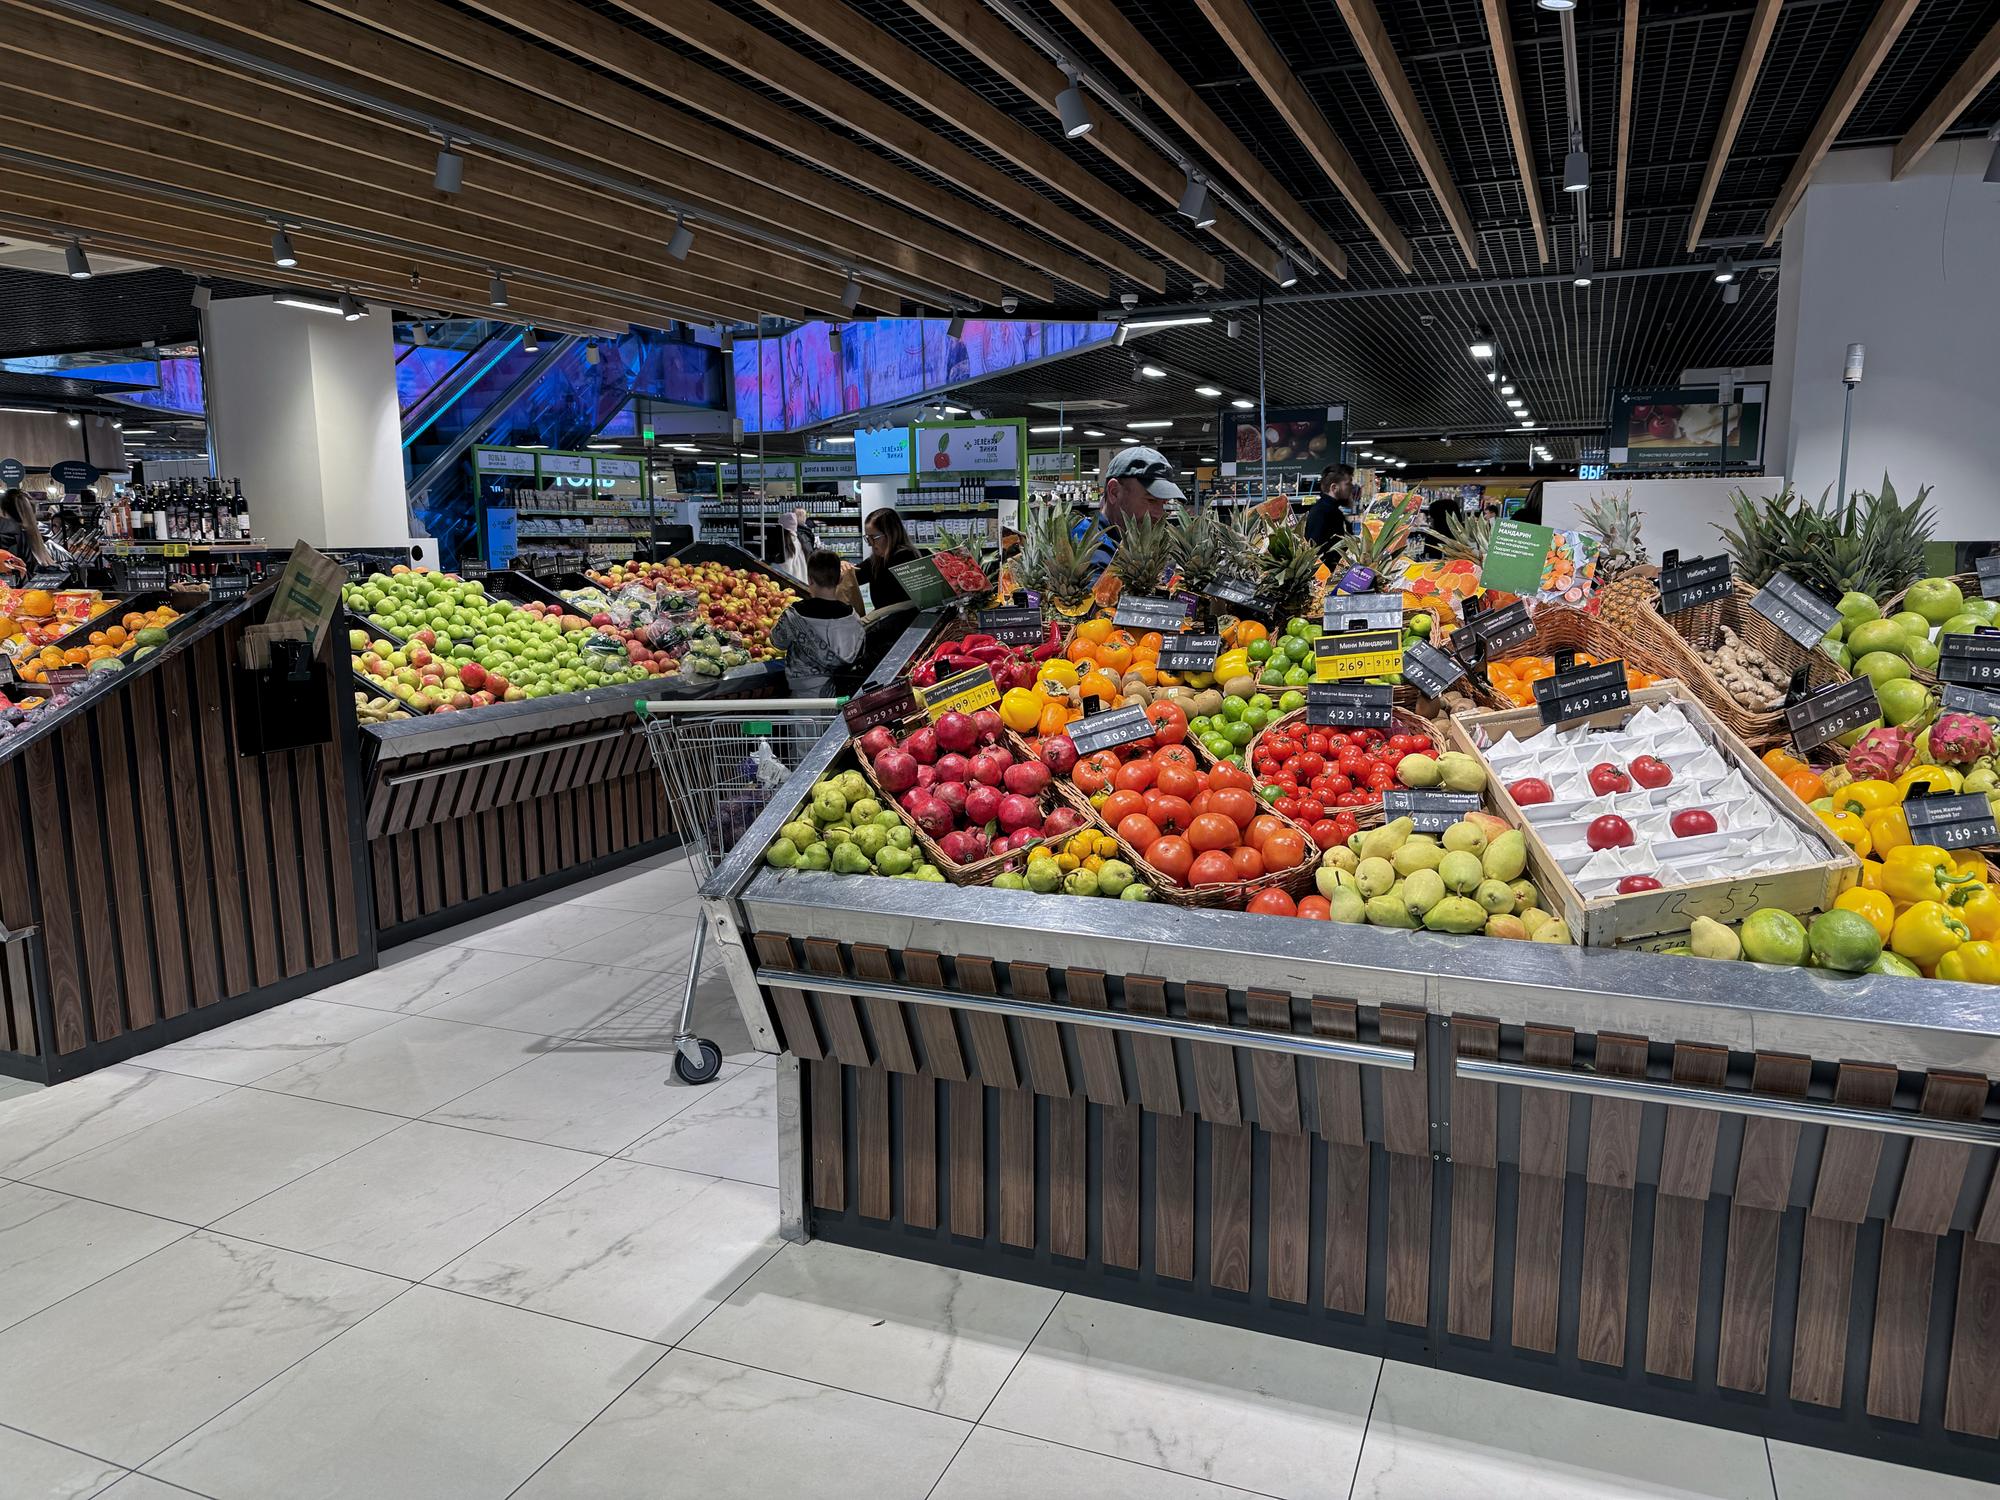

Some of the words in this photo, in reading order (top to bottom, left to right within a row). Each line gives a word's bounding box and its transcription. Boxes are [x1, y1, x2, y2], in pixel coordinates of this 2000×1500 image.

[1500, 521, 1518, 529] МИНИ
[1498, 528, 1532, 539] МАНДАРИН
[1358, 640, 1393, 648] Мандарин
